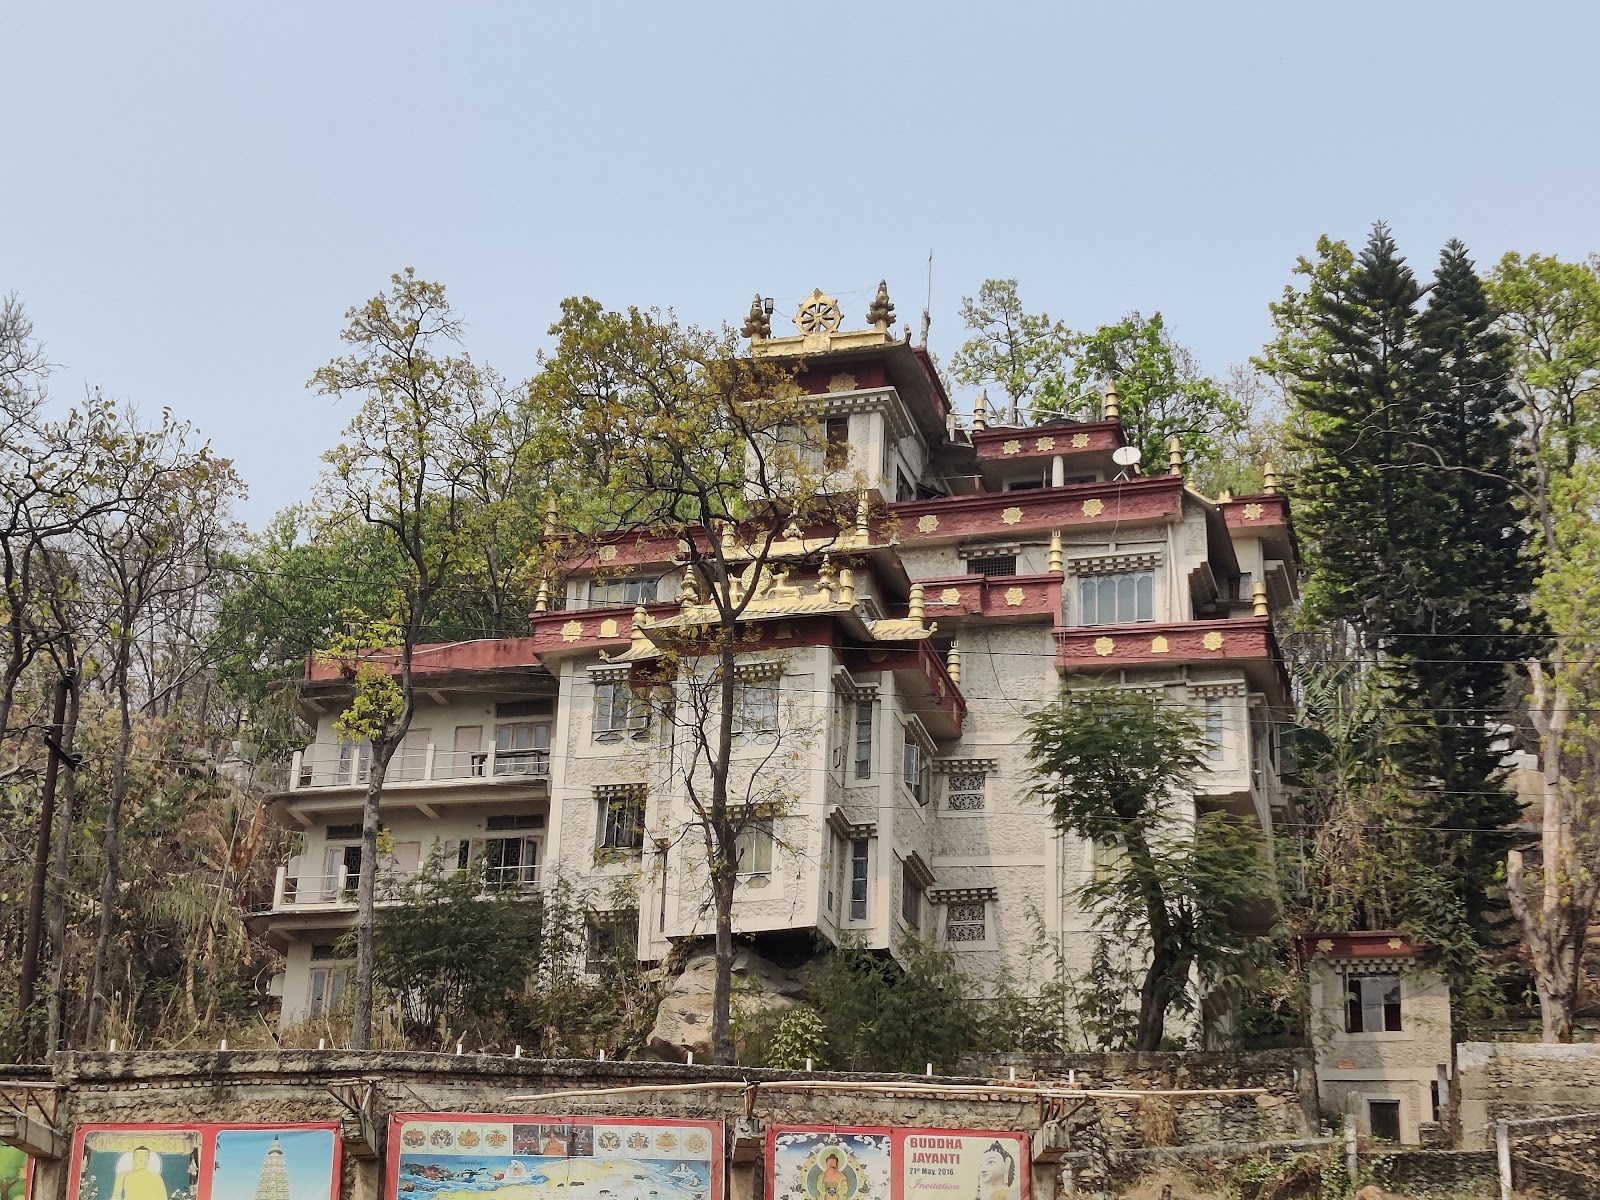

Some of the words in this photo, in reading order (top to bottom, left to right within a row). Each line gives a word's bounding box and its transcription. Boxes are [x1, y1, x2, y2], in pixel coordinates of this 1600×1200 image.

[910, 1138, 962, 1149] BUDDHA
[912, 1153, 960, 1164] JAYANTI
[908, 1178, 960, 1190] Invitation
